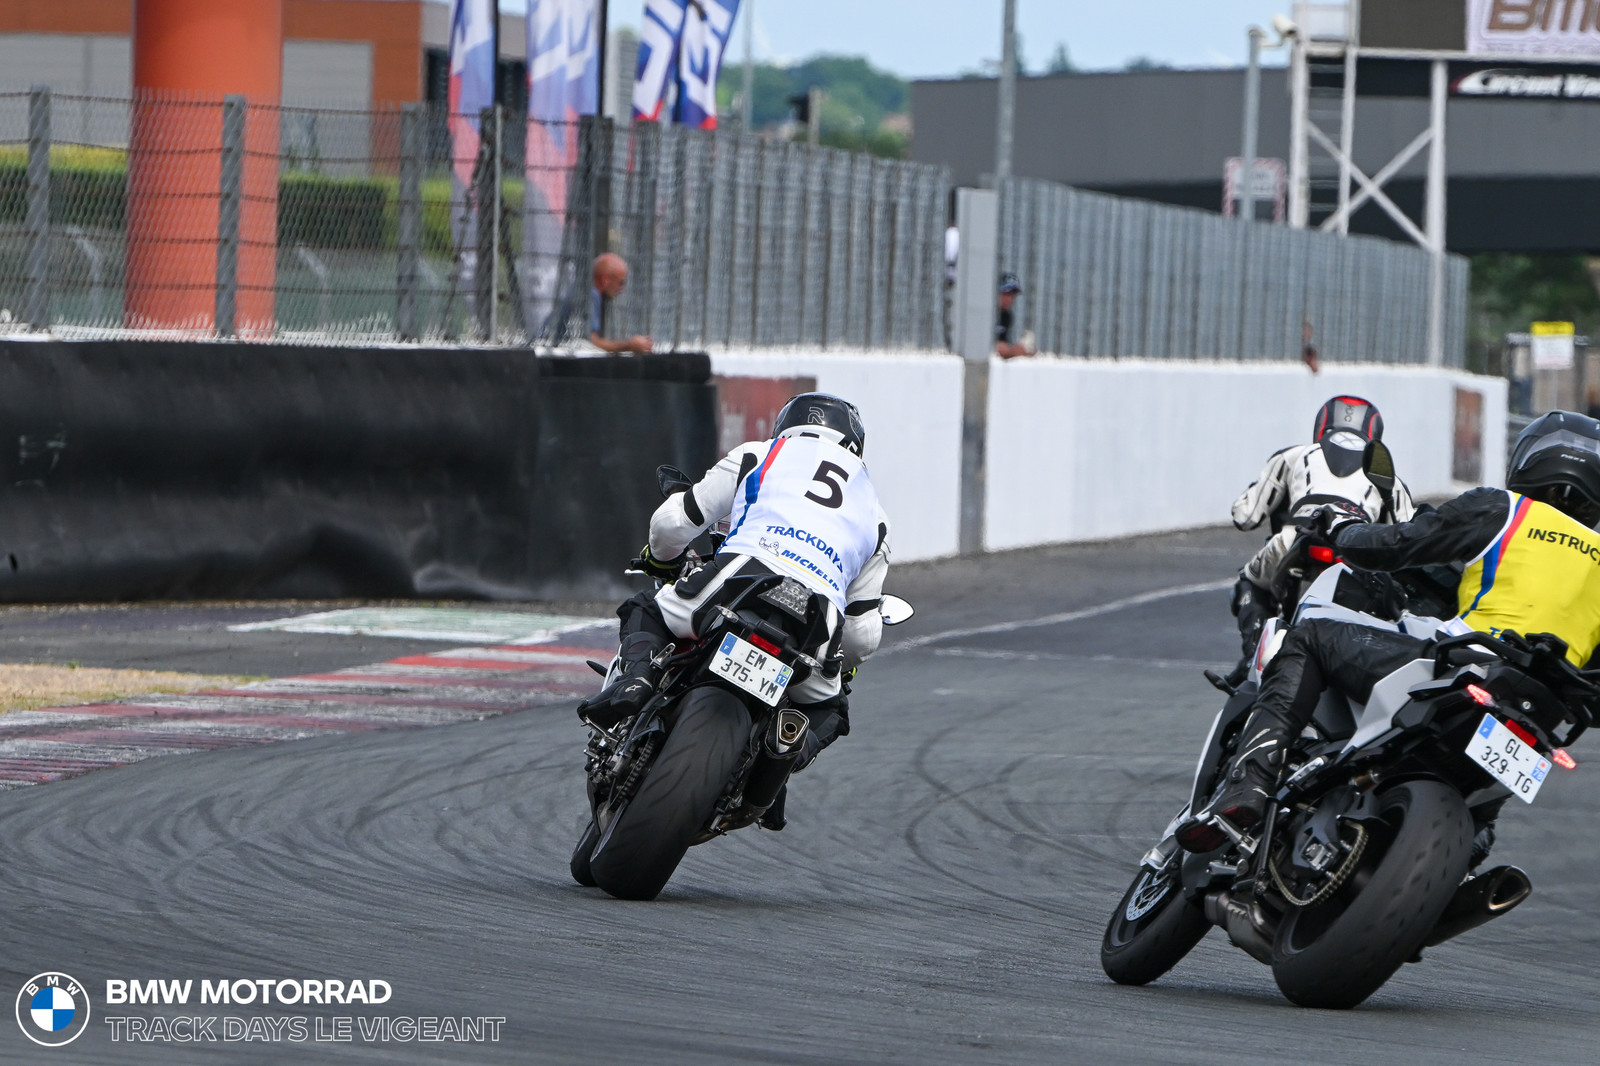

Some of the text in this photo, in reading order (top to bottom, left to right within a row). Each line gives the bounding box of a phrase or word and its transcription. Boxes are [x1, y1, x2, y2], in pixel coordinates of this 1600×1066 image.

[804, 460, 850, 509] 5
[1527, 528, 1600, 566] INSTRUC
[781, 549, 840, 592] MICHELIN
[745, 649, 768, 671] EM
[759, 677, 779, 699] YM
[777, 675, 787, 685] 17
[1505, 738, 1521, 761] GL
[1515, 771, 1533, 794] TG
